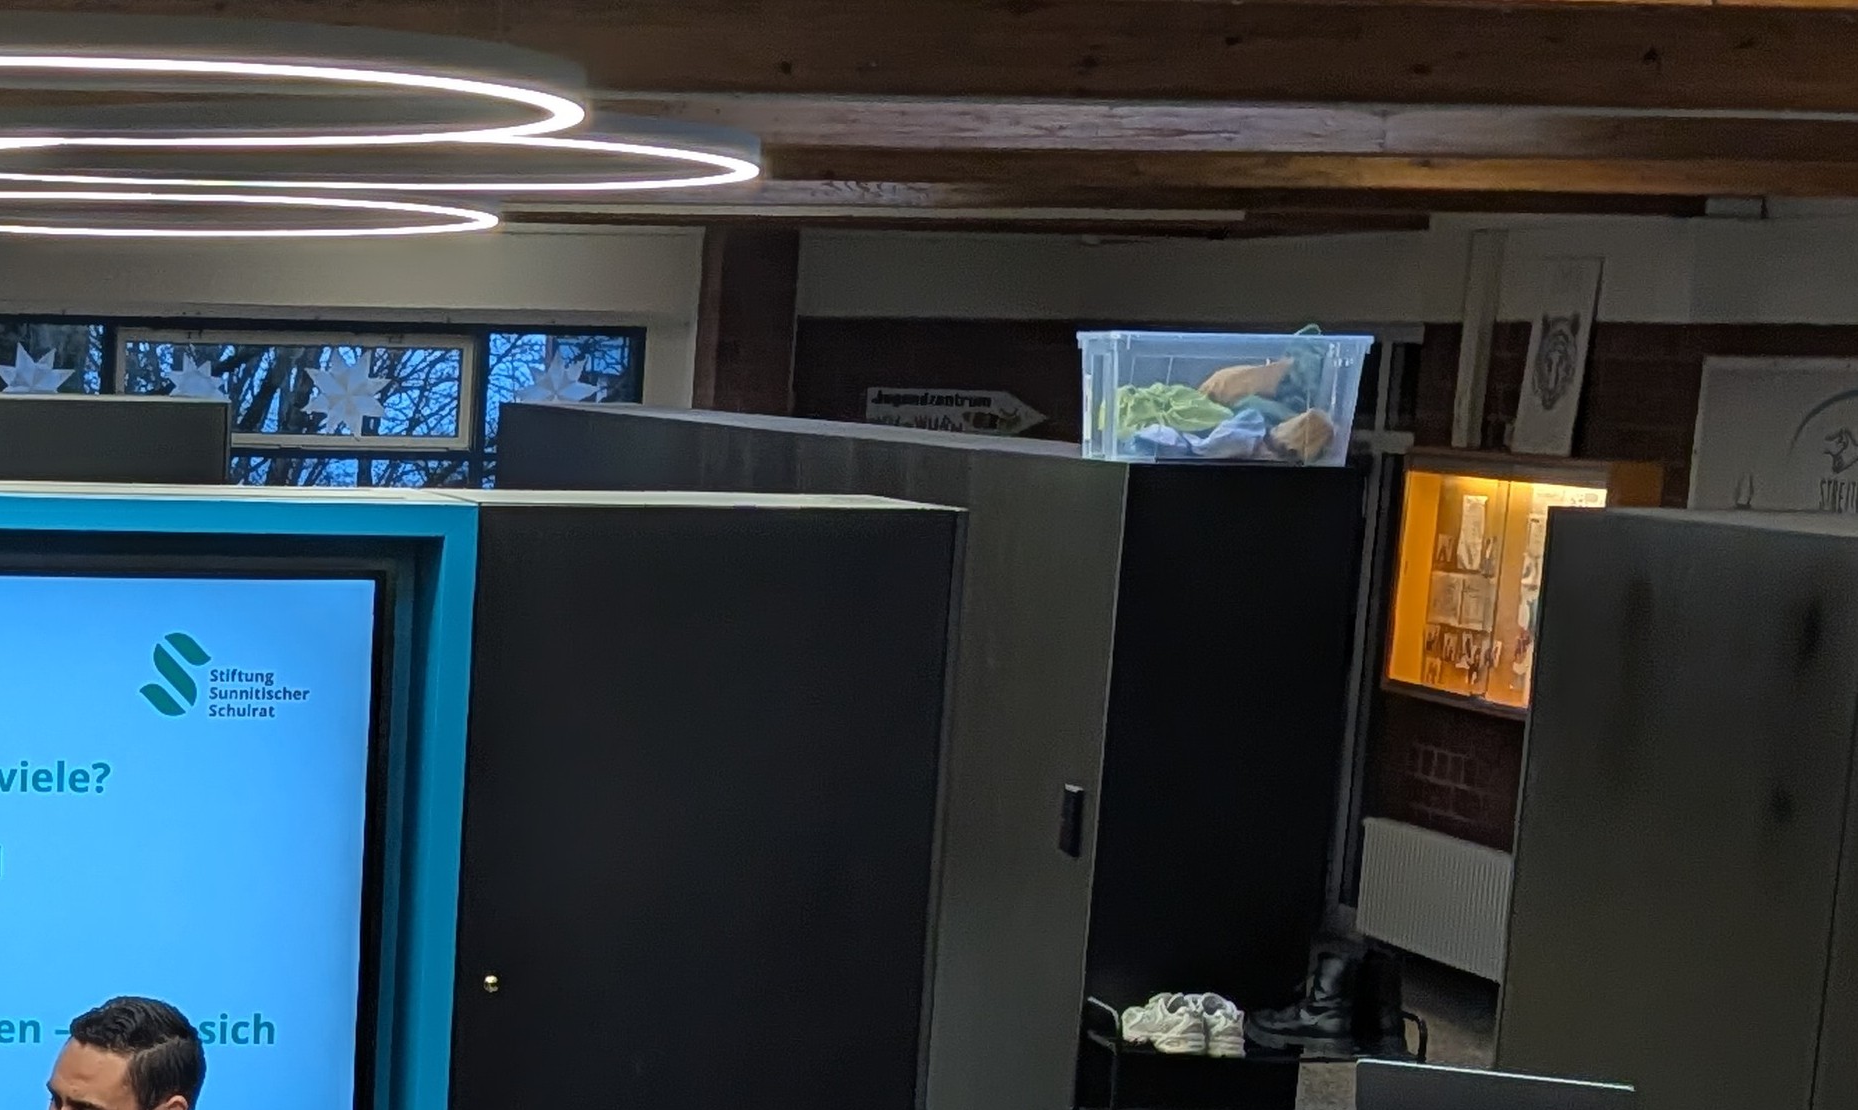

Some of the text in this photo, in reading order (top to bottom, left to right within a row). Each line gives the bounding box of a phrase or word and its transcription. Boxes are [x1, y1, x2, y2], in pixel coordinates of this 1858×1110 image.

[1820, 479, 1858, 513] STREIT
[210, 669, 274, 688] Stiftung
[209, 686, 310, 700] Sunnitischer
[209, 704, 275, 718] Schulrat
[199, 1013, 275, 1045] sich
